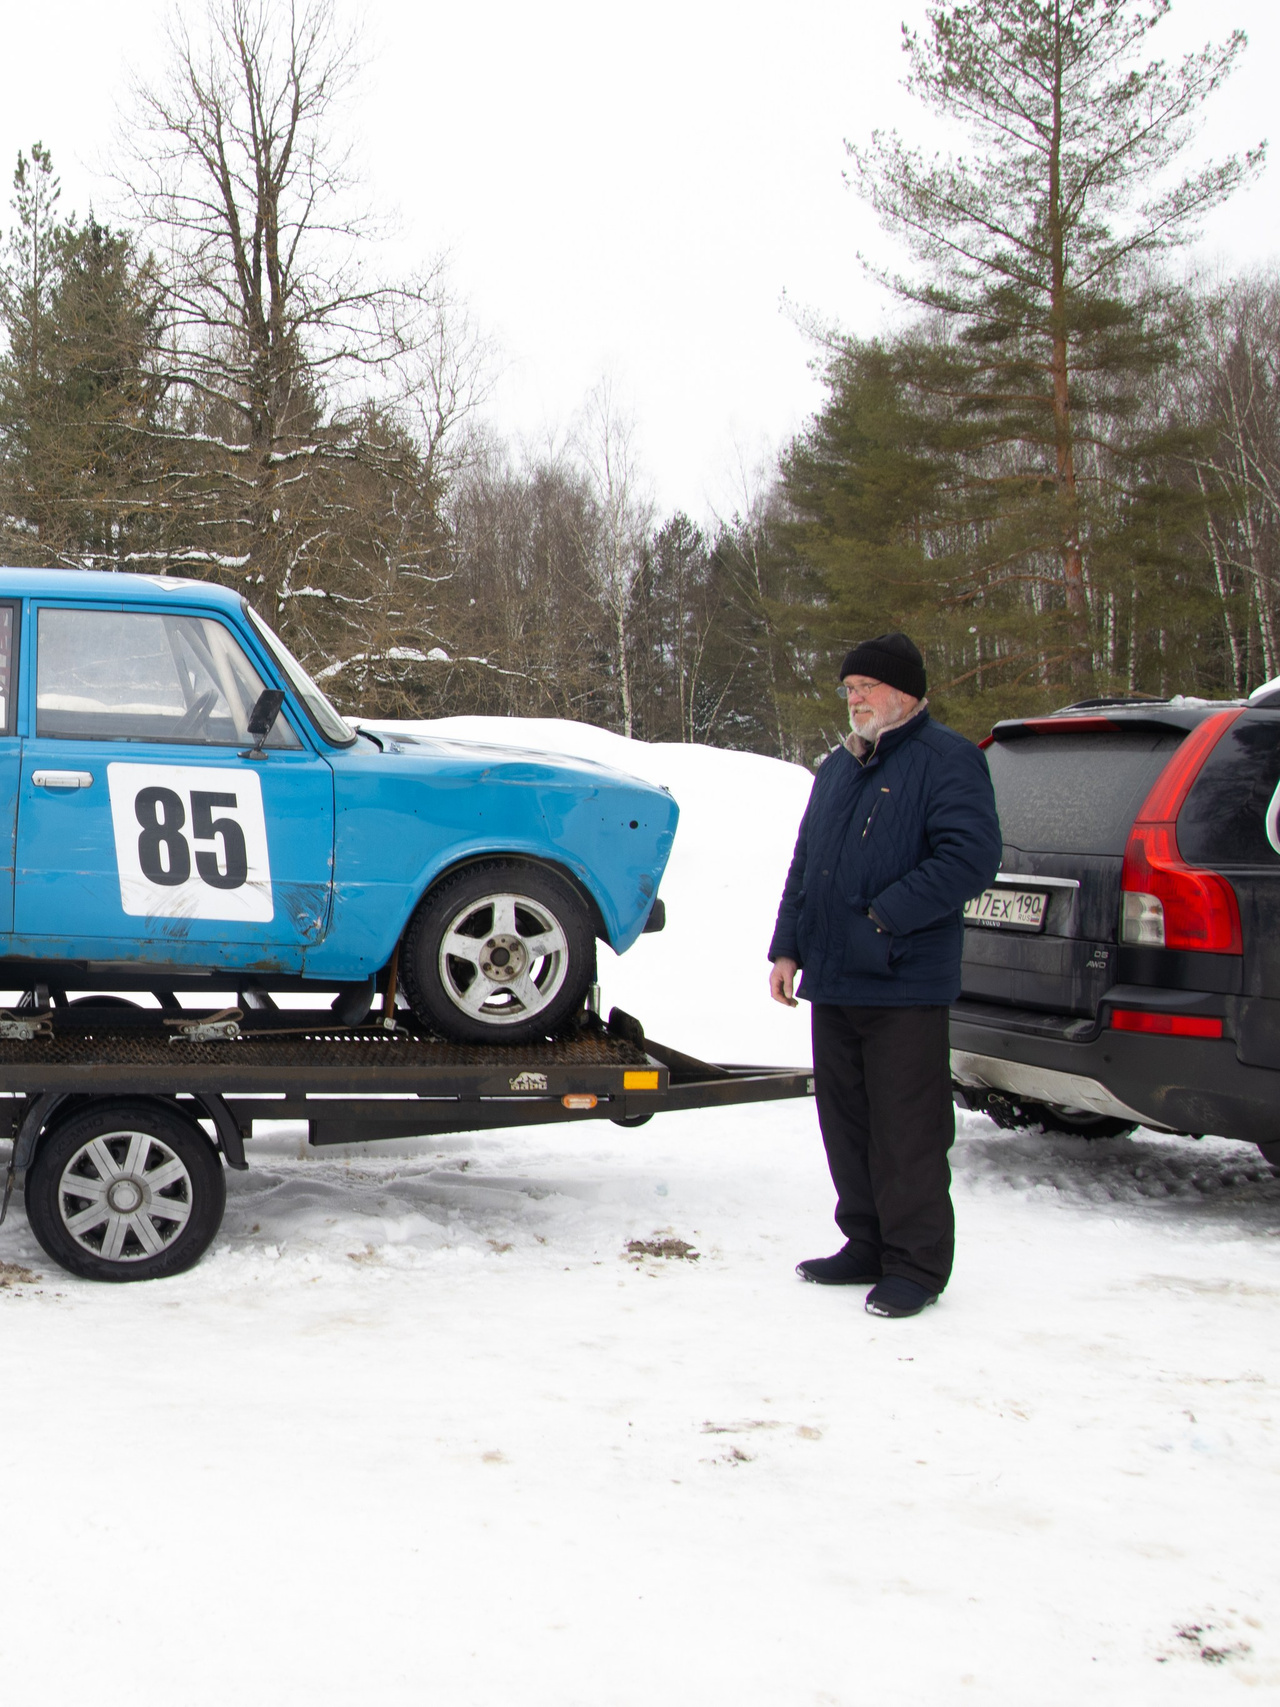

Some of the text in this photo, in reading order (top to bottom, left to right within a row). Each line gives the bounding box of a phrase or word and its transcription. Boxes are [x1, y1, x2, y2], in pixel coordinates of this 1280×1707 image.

[134, 787, 248, 890] 85
[1017, 895, 1041, 914] 190
[1017, 914, 1031, 922] RUS
[1086, 960, 1106, 969] AWD
